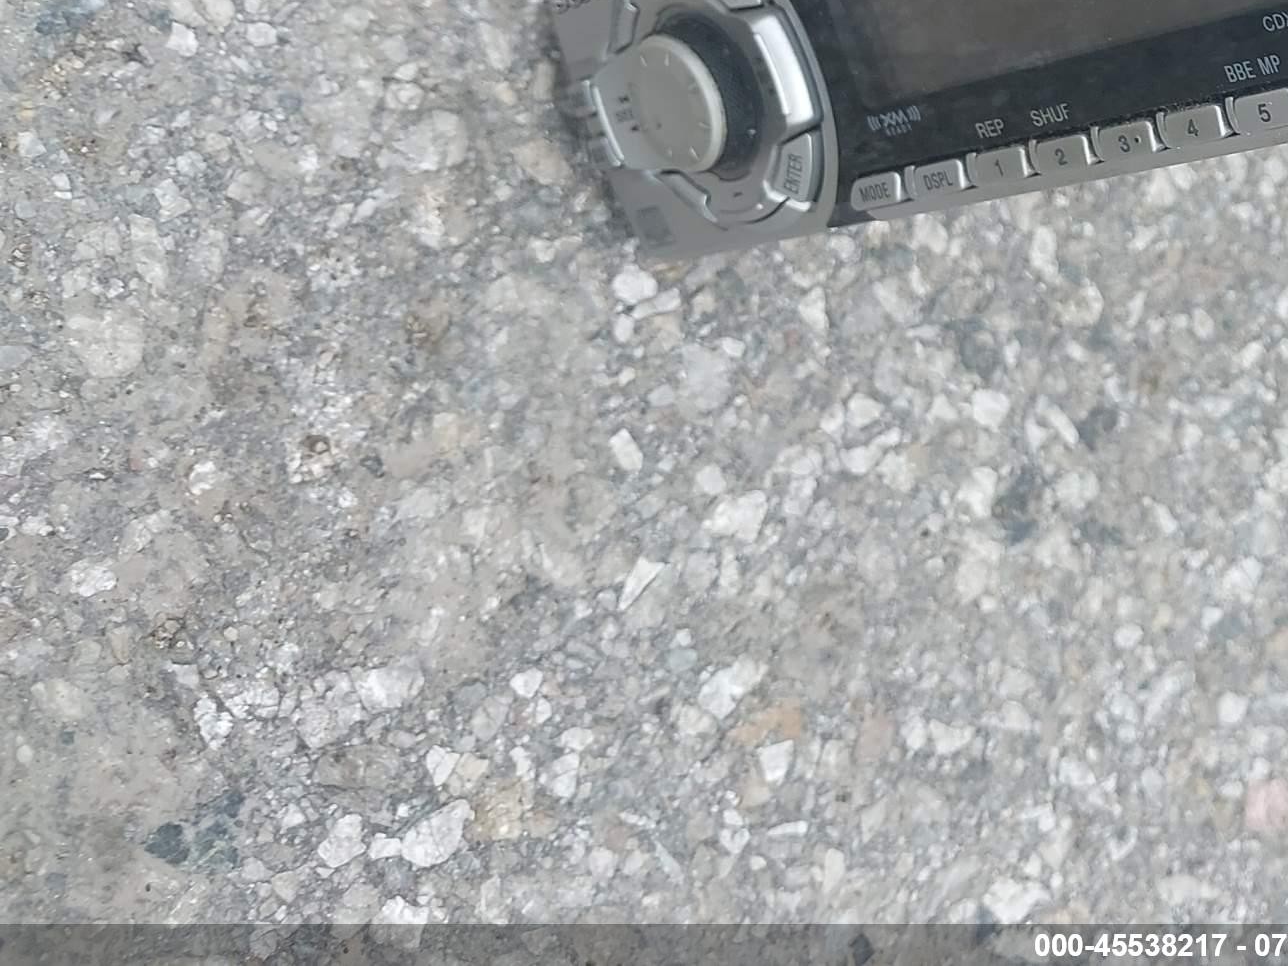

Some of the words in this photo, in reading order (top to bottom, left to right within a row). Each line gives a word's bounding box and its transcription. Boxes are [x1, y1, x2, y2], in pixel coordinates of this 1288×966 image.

[1224, 58, 1256, 83] BBE
[1258, 53, 1281, 74] MP
[1030, 103, 1071, 127] SHUF
[1258, 102, 1272, 123] 5
[975, 118, 1005, 139] REP
[1186, 118, 1199, 137] 4
[1118, 135, 1132, 153] 3
[1054, 147, 1068, 166] 2
[784, 153, 803, 195] ENTER
[993, 158, 1003, 177] 1
[923, 171, 953, 191] DSPL
[858, 181, 890, 204] MODE
